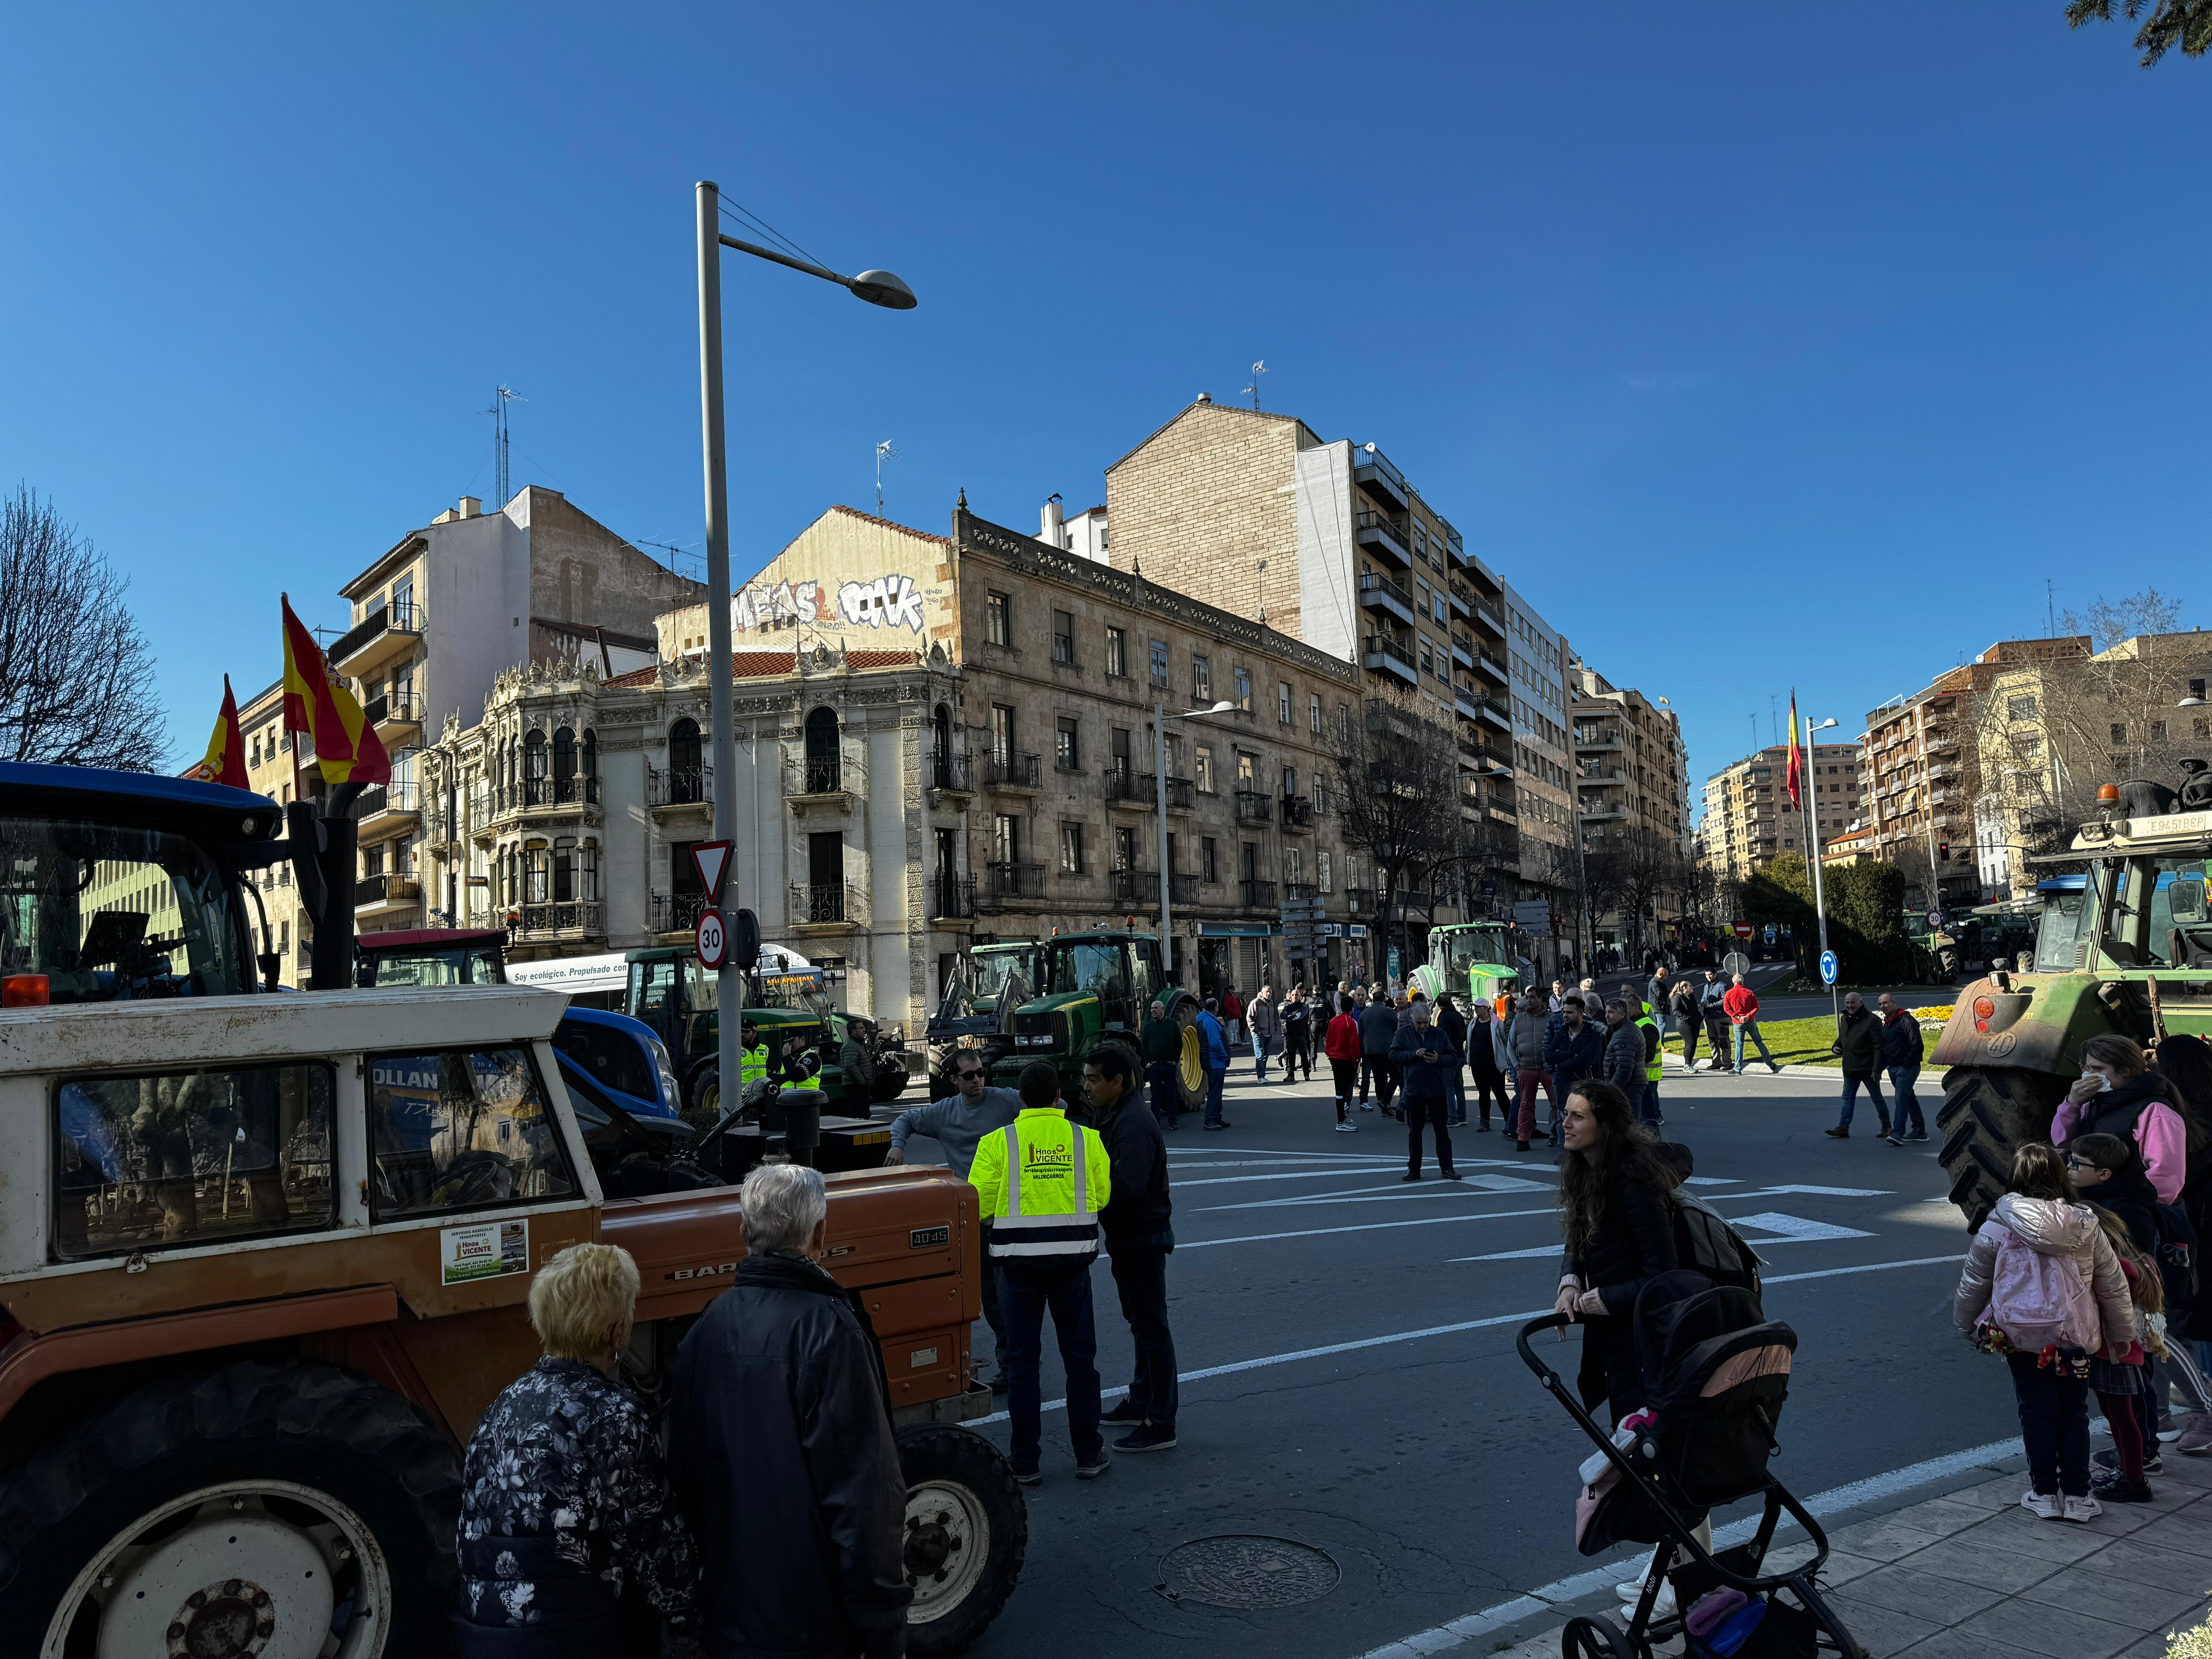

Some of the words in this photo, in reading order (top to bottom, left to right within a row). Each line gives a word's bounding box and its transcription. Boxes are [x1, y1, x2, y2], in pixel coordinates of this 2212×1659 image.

[702, 928, 720, 949] 30
[515, 973, 527, 982] Soy
[530, 970, 566, 979] ecológico.
[569, 966, 610, 977] Propulsado
[1989, 1035, 2013, 1053] 40
[372, 1068, 438, 1089] OLLAN
[463, 1246, 491, 1255] VICENTE
[1646, 1573, 1656, 1594] Mobi
